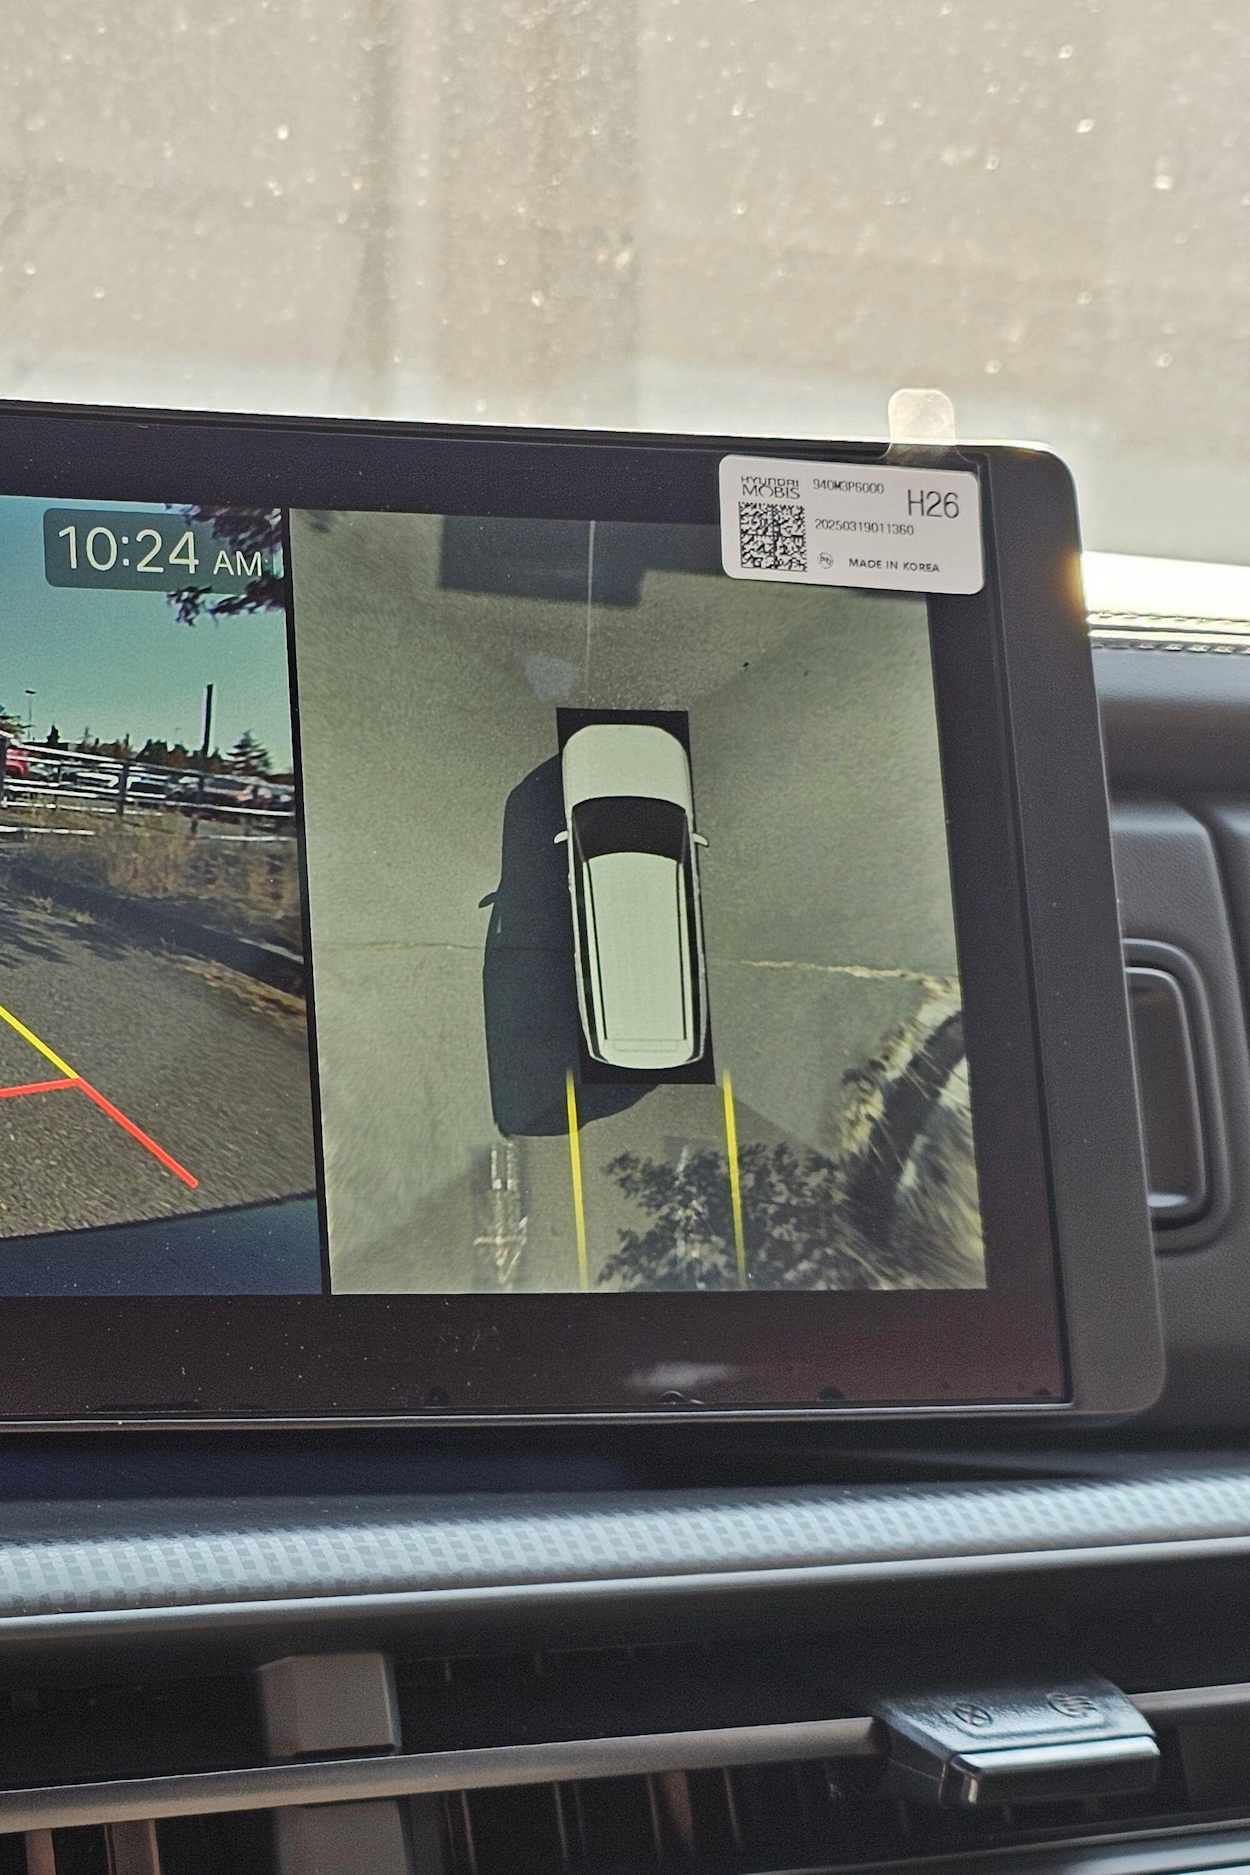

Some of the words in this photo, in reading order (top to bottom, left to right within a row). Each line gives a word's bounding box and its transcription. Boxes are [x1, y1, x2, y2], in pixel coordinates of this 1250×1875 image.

[741, 476, 799, 487] HYUNDAI
[742, 484, 800, 499] MOBIS
[907, 489, 959, 518] H26
[814, 518, 915, 536] 20250319011360
[58, 525, 199, 574] 10:24
[213, 550, 262, 576] AM
[848, 558, 882, 569] MADE
[886, 560, 898, 570] IN
[902, 561, 940, 573] KOREA
